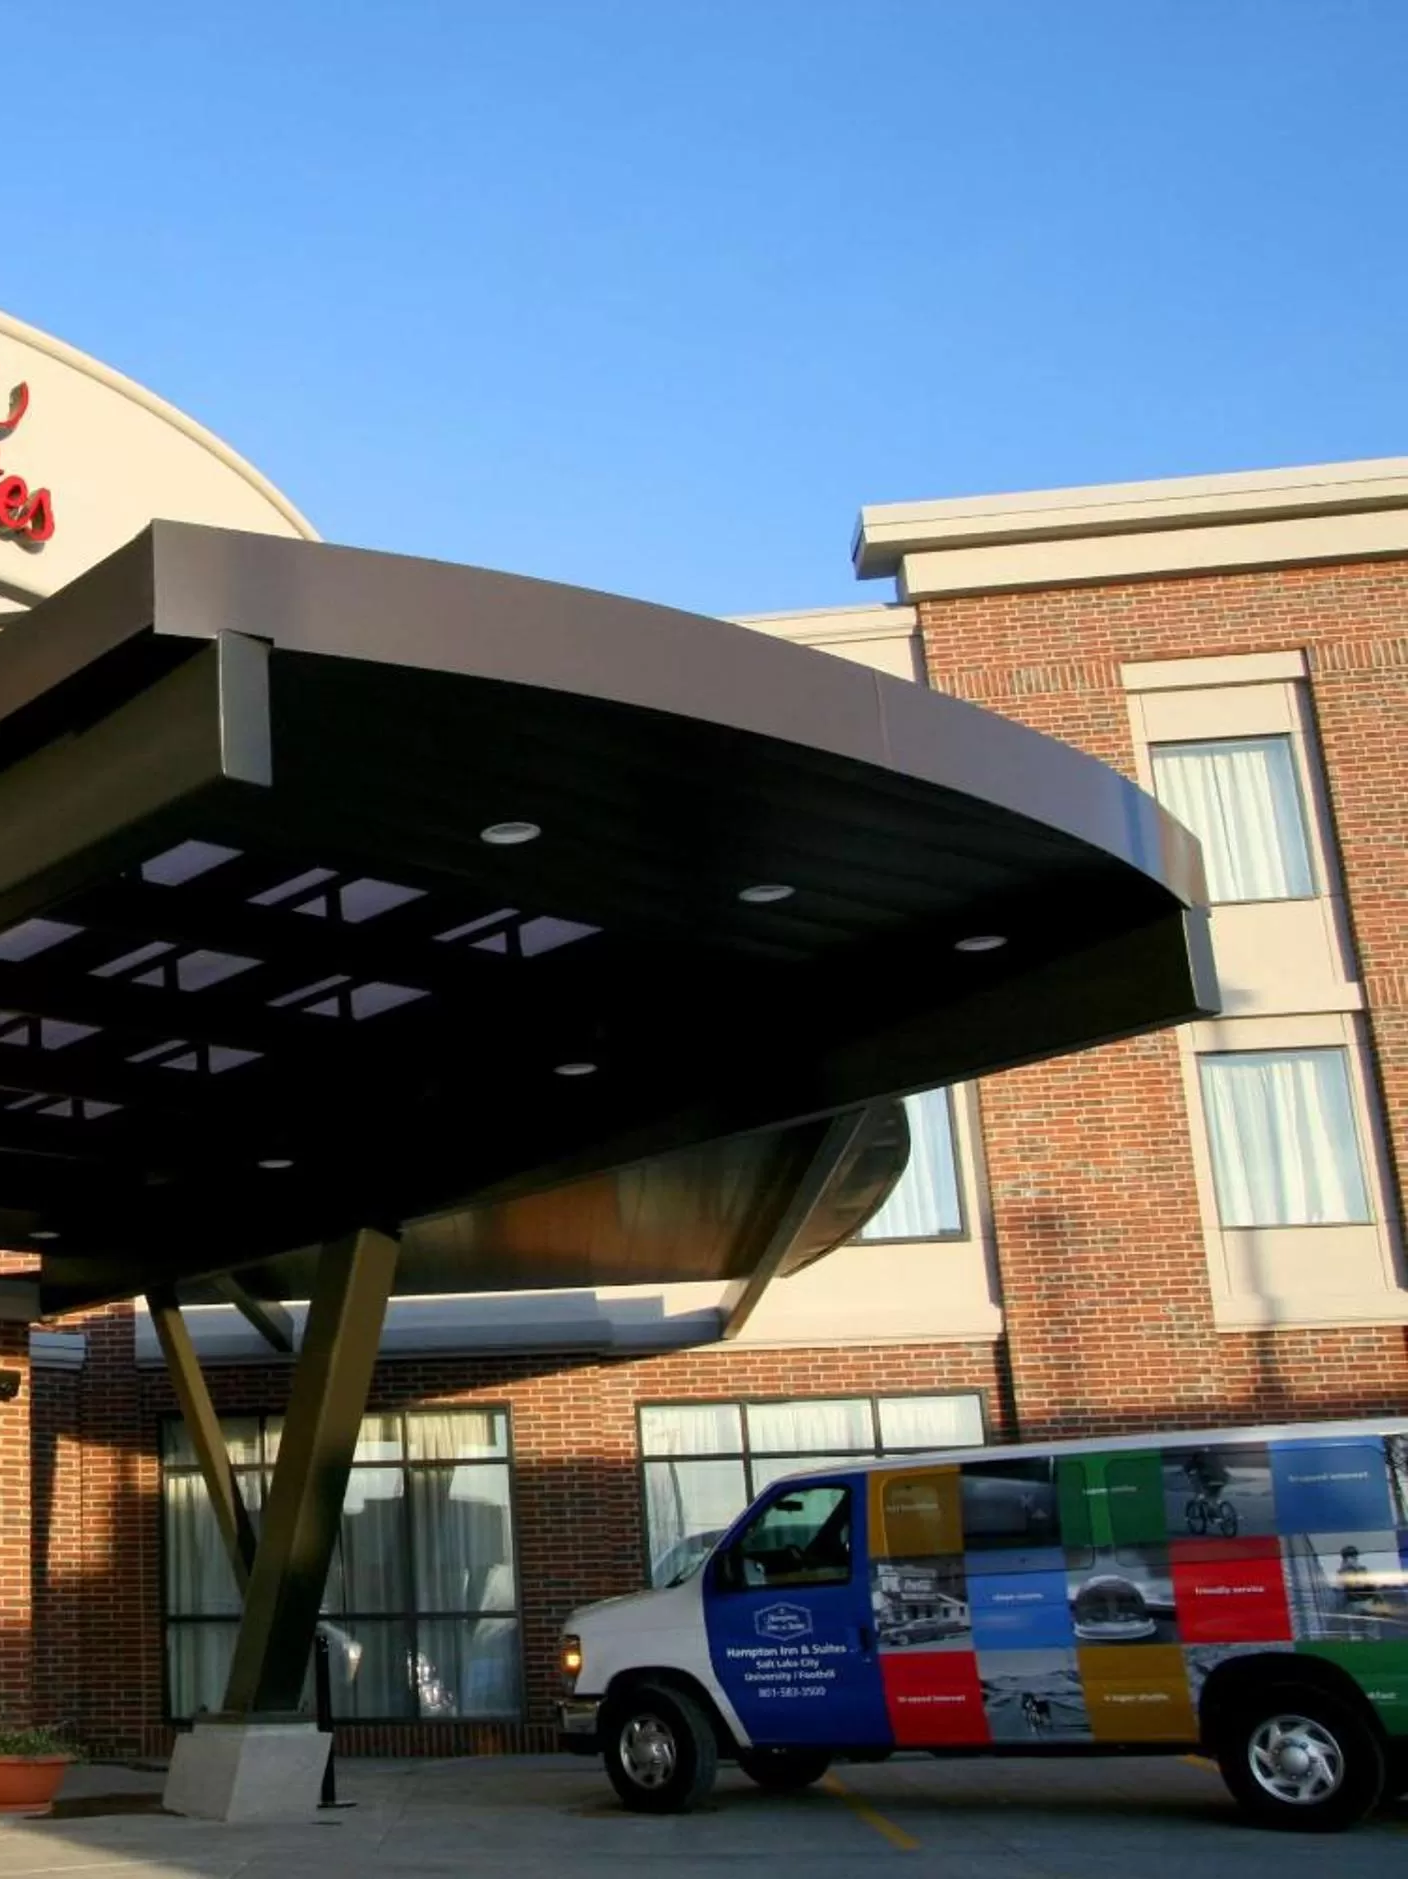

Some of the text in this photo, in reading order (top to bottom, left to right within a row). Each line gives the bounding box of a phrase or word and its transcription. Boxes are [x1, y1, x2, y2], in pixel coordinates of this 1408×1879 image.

[726, 1647, 778, 1660] Hampton
[780, 1646, 799, 1656] Inn
[812, 1642, 847, 1655] Suites
